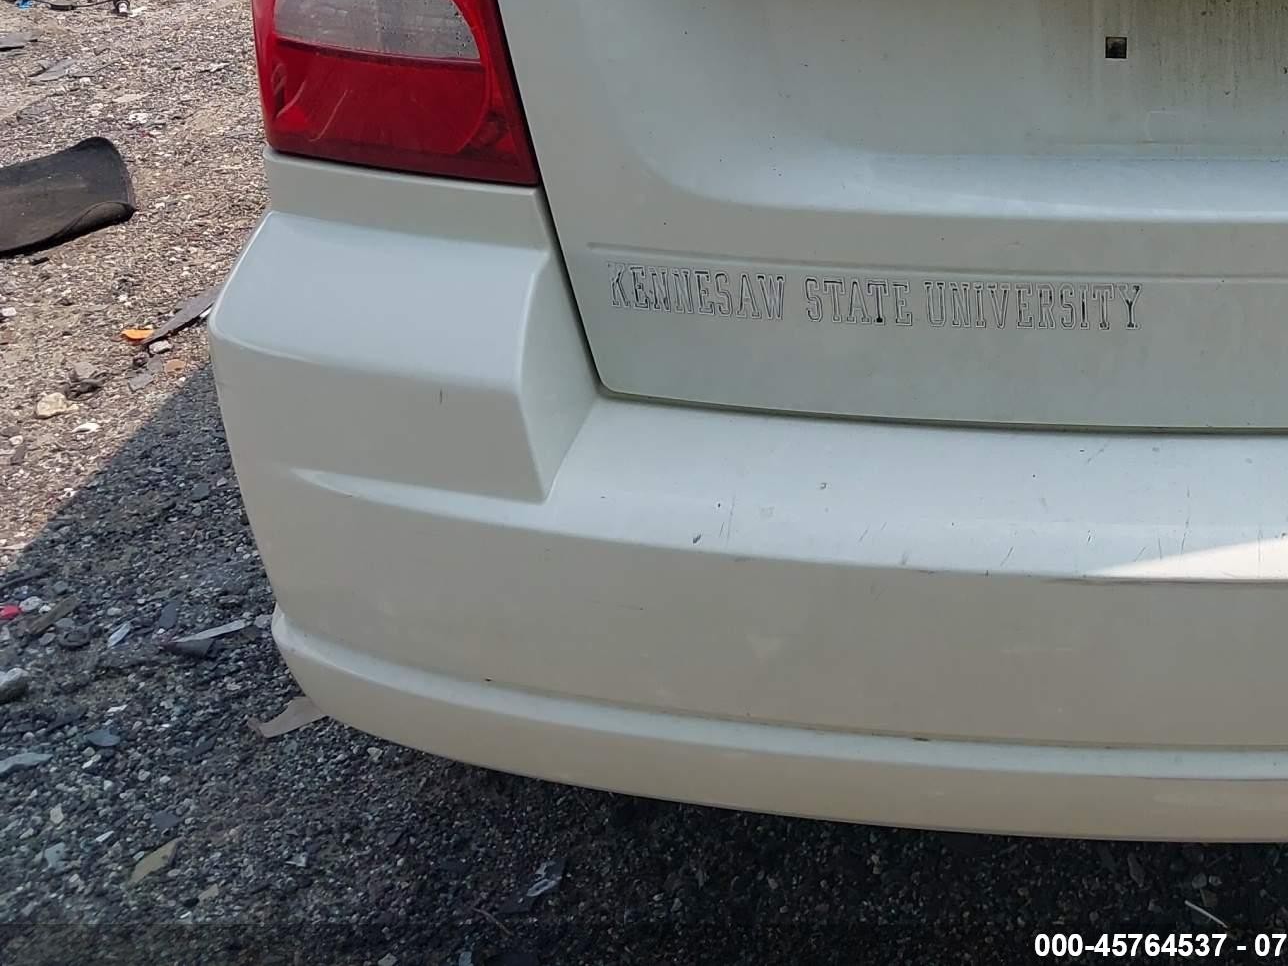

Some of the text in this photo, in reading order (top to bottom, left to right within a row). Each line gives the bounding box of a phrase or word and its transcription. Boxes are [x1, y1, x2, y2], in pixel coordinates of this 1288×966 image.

[607, 263, 1144, 331] KENNESAW STATE UNIVERSITY
